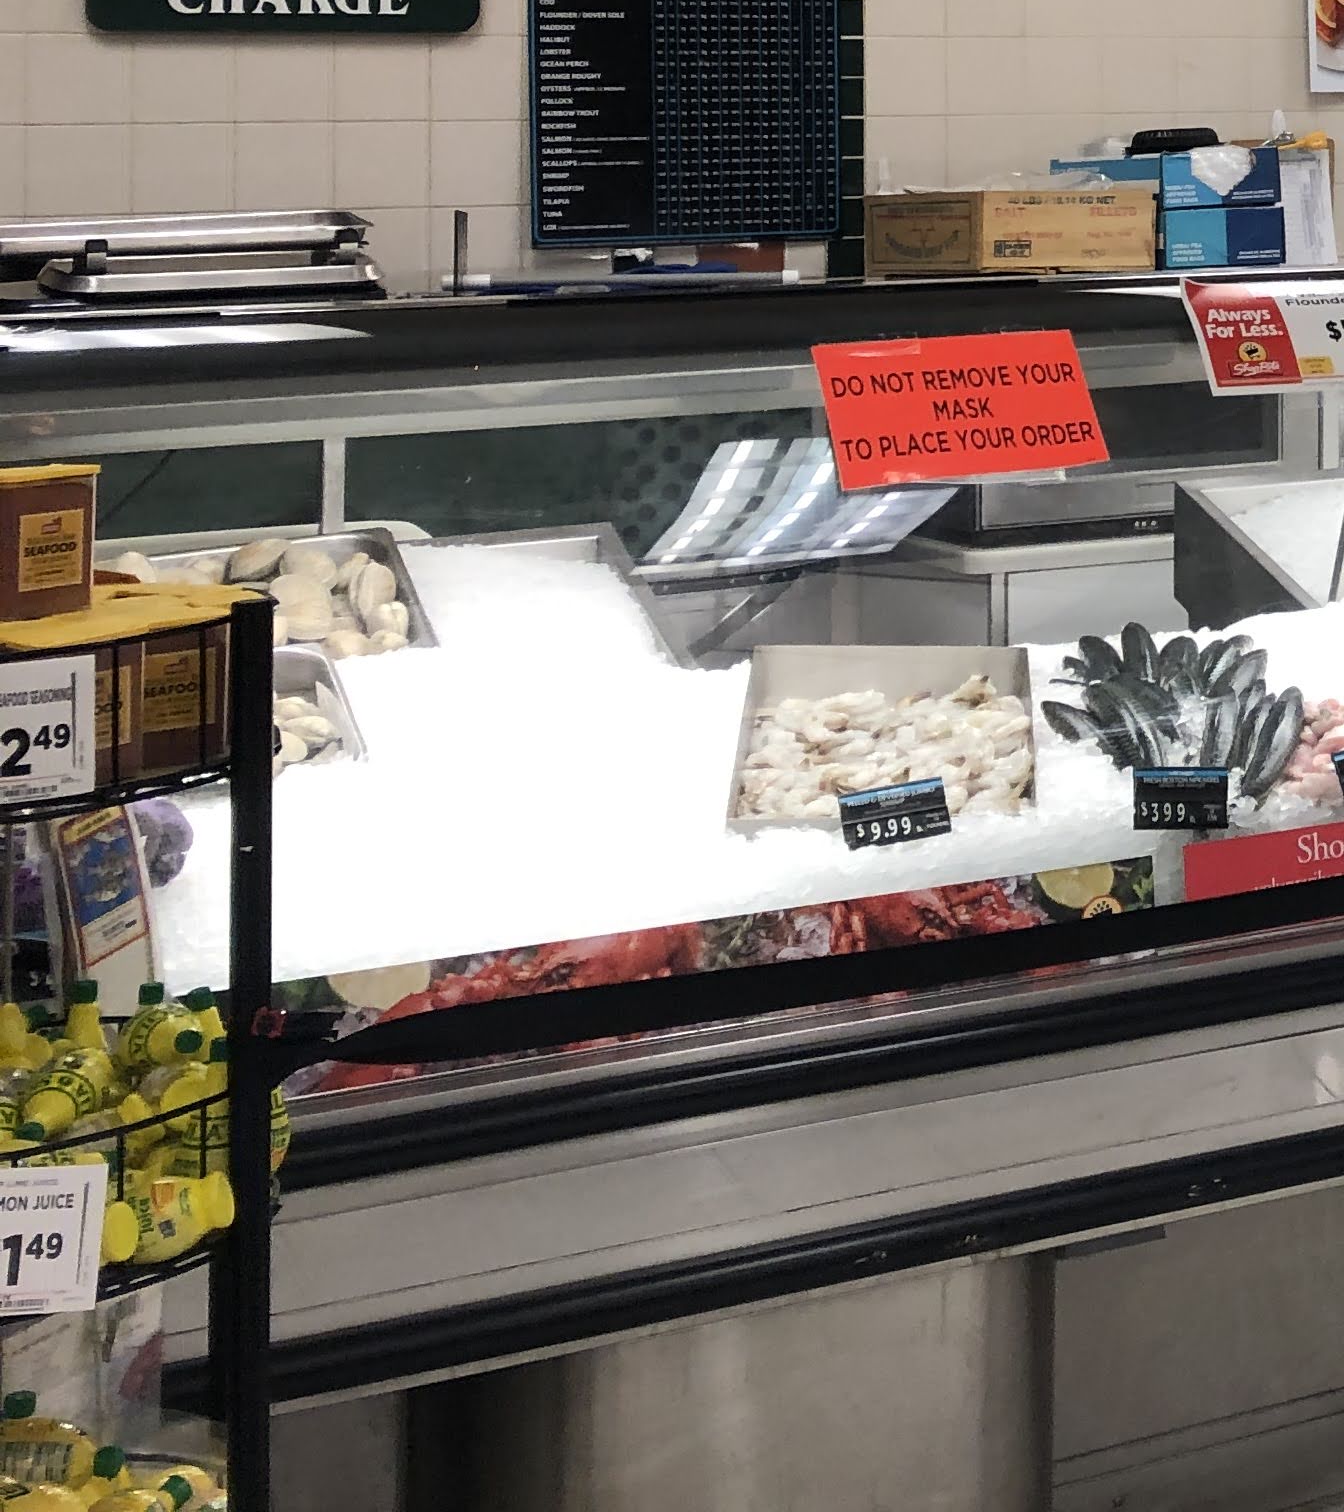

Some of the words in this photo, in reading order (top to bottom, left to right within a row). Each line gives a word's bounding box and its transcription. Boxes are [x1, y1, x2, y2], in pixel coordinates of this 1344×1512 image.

[1206, 308, 1271, 324] Always
[1204, 324, 1236, 340] For
[1239, 324, 1285, 339] Less.
[831, 375, 864, 398] DO
[870, 371, 914, 394] NOT
[922, 365, 1012, 391] REMOVE
[1015, 362, 1076, 385] YOUR
[932, 397, 994, 422] MASK
[840, 437, 873, 463] TO
[880, 430, 952, 458] PLACE
[953, 426, 1018, 451] YOUR
[1021, 420, 1096, 446] ORDER
[23, 542, 77, 558] SEAFOOD
[143, 681, 207, 699] SEAFOO
[32, 1193, 75, 1210] JUICE
